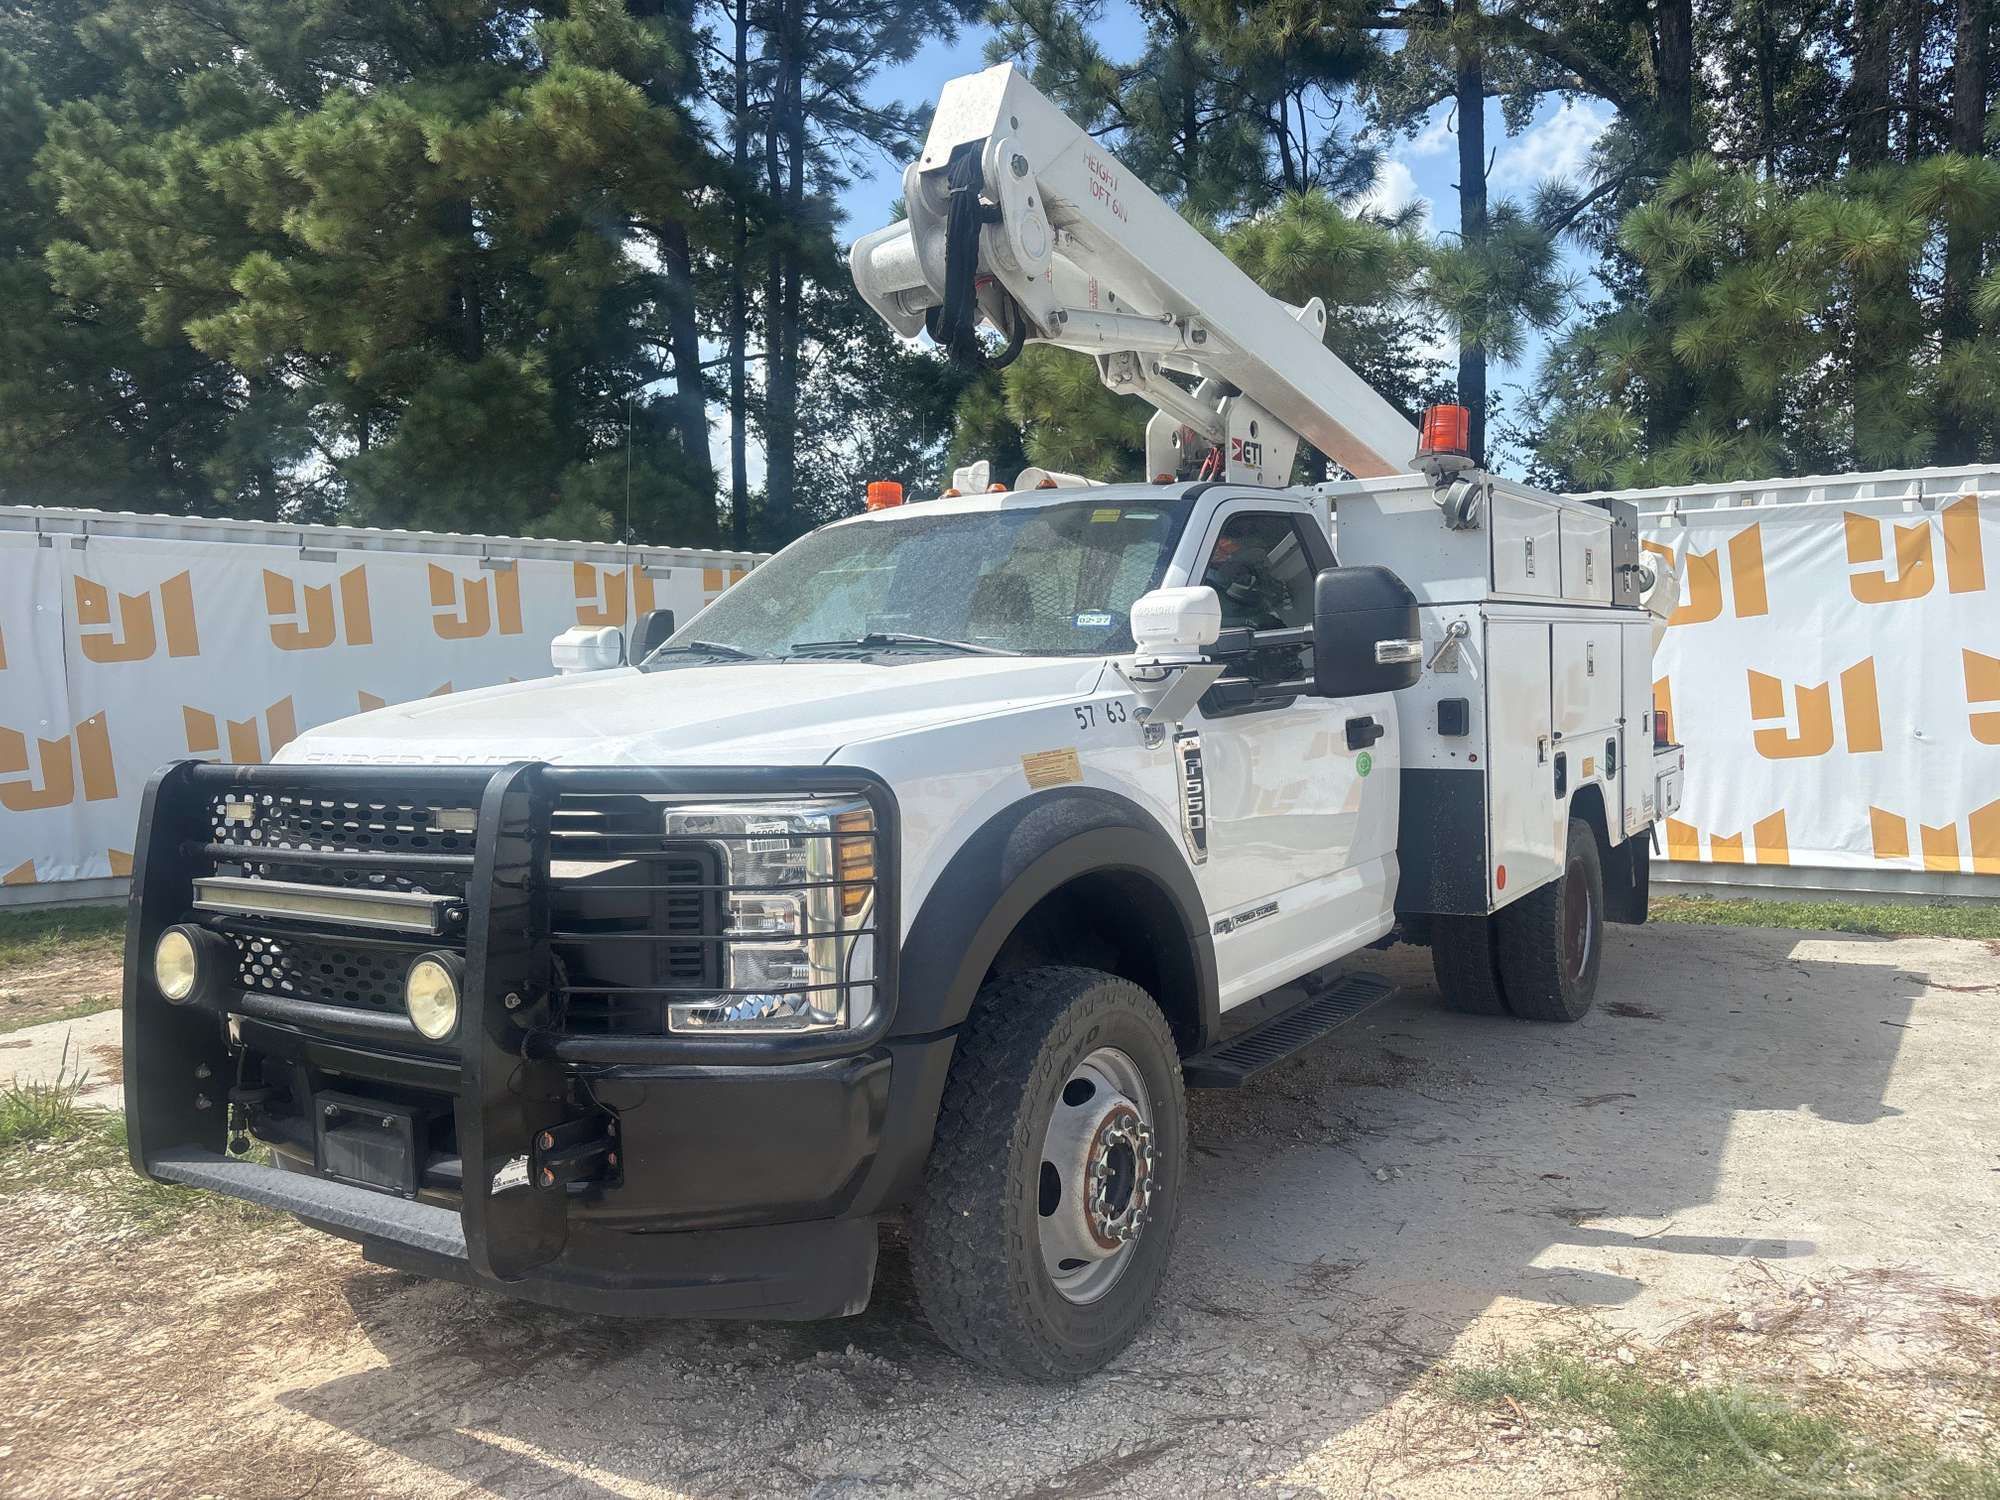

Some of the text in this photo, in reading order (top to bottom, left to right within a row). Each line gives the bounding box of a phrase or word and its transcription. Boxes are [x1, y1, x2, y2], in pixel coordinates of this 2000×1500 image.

[1243, 440, 1262, 466] ETI
[1074, 701, 1127, 730] 57 63
